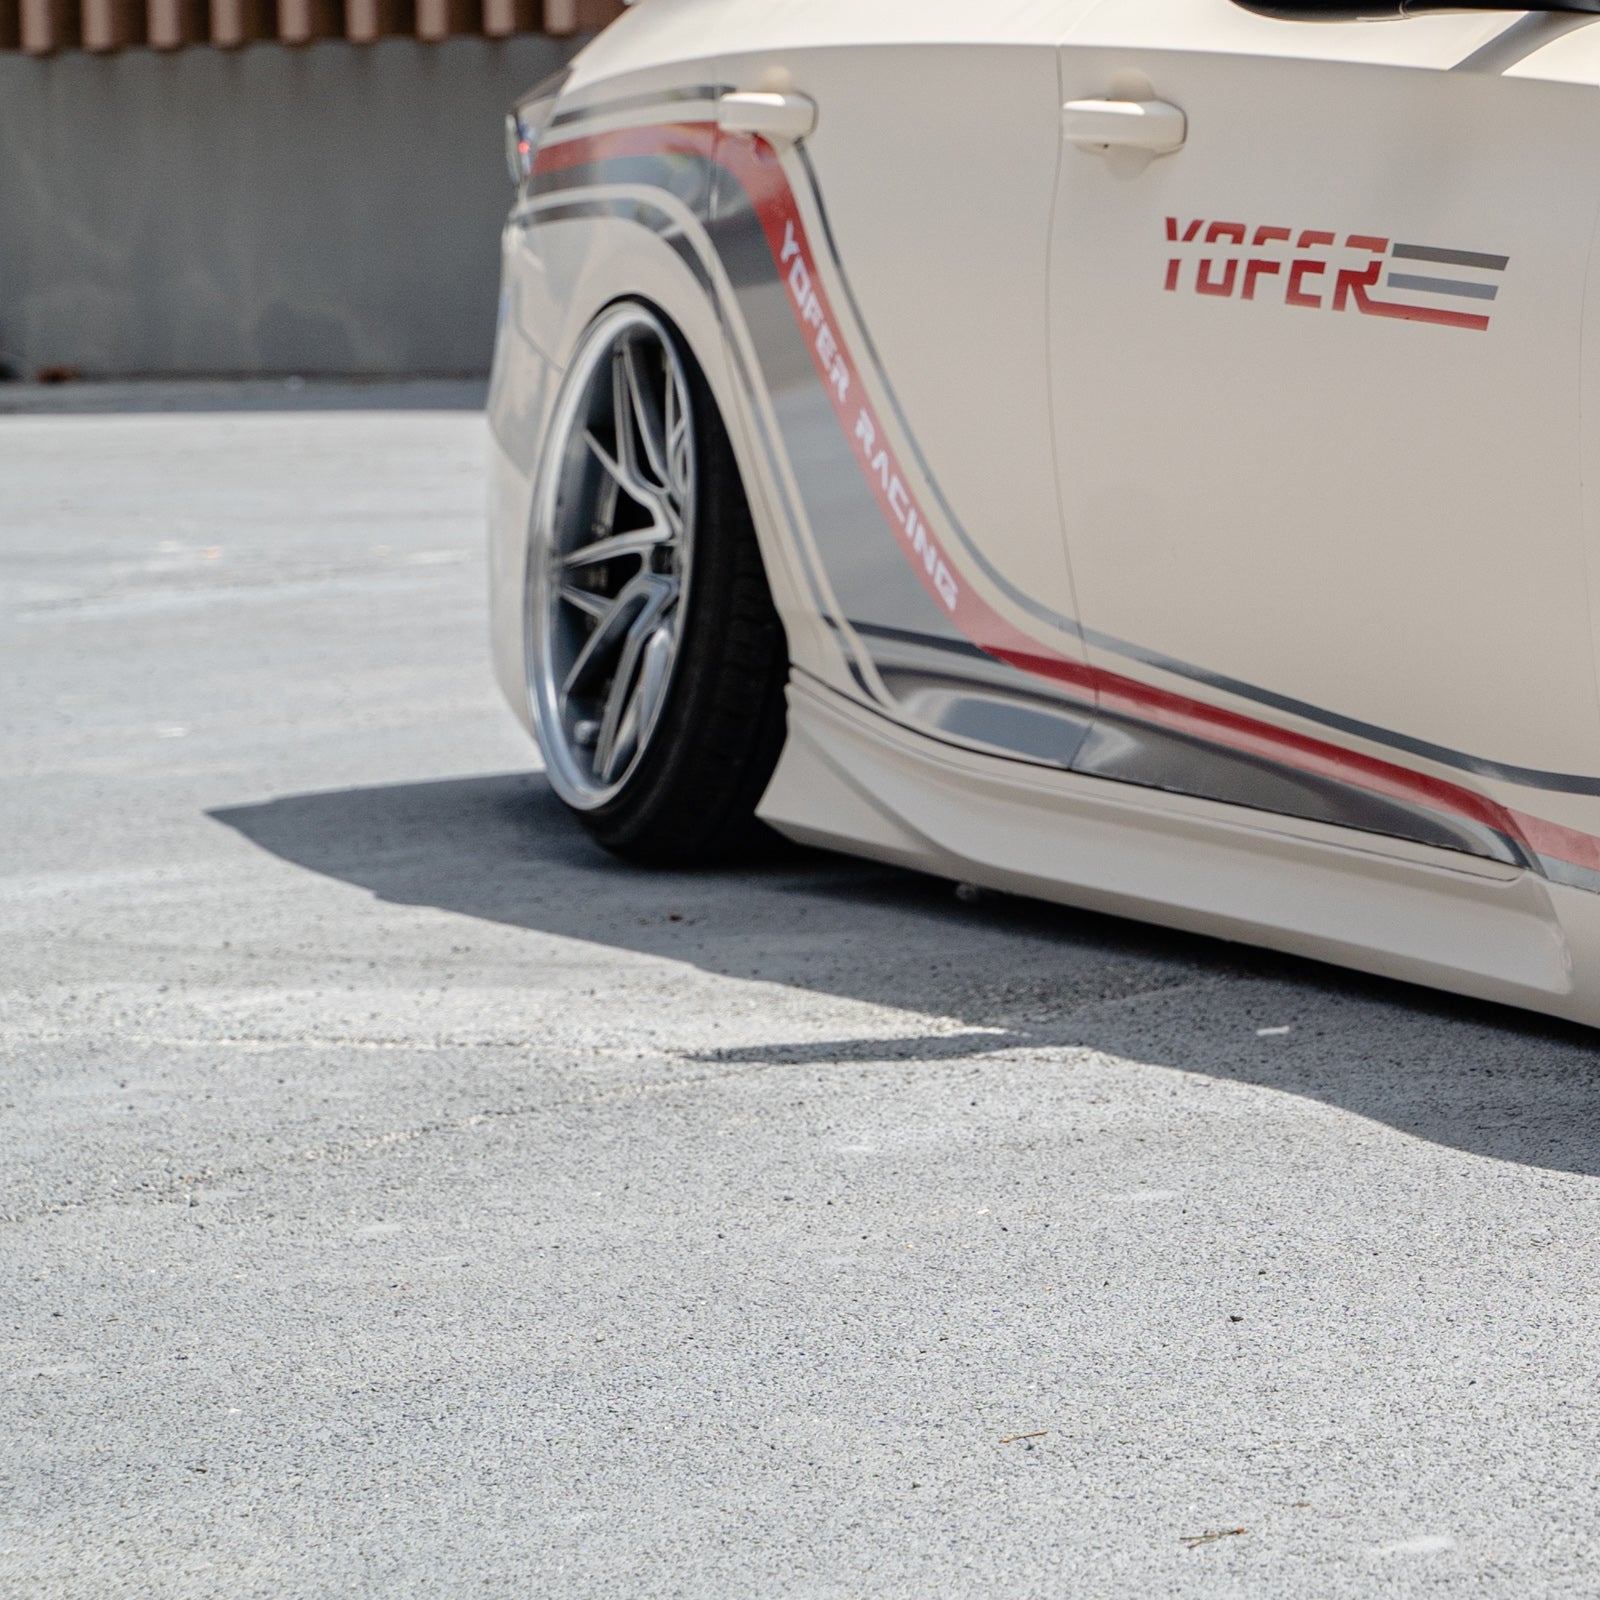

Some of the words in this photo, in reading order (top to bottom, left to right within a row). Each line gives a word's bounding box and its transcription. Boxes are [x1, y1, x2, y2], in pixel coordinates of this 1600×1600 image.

[1164, 217, 1490, 331] YOFER
[781, 219, 851, 402] YOFER
[855, 408, 958, 612] RACING
